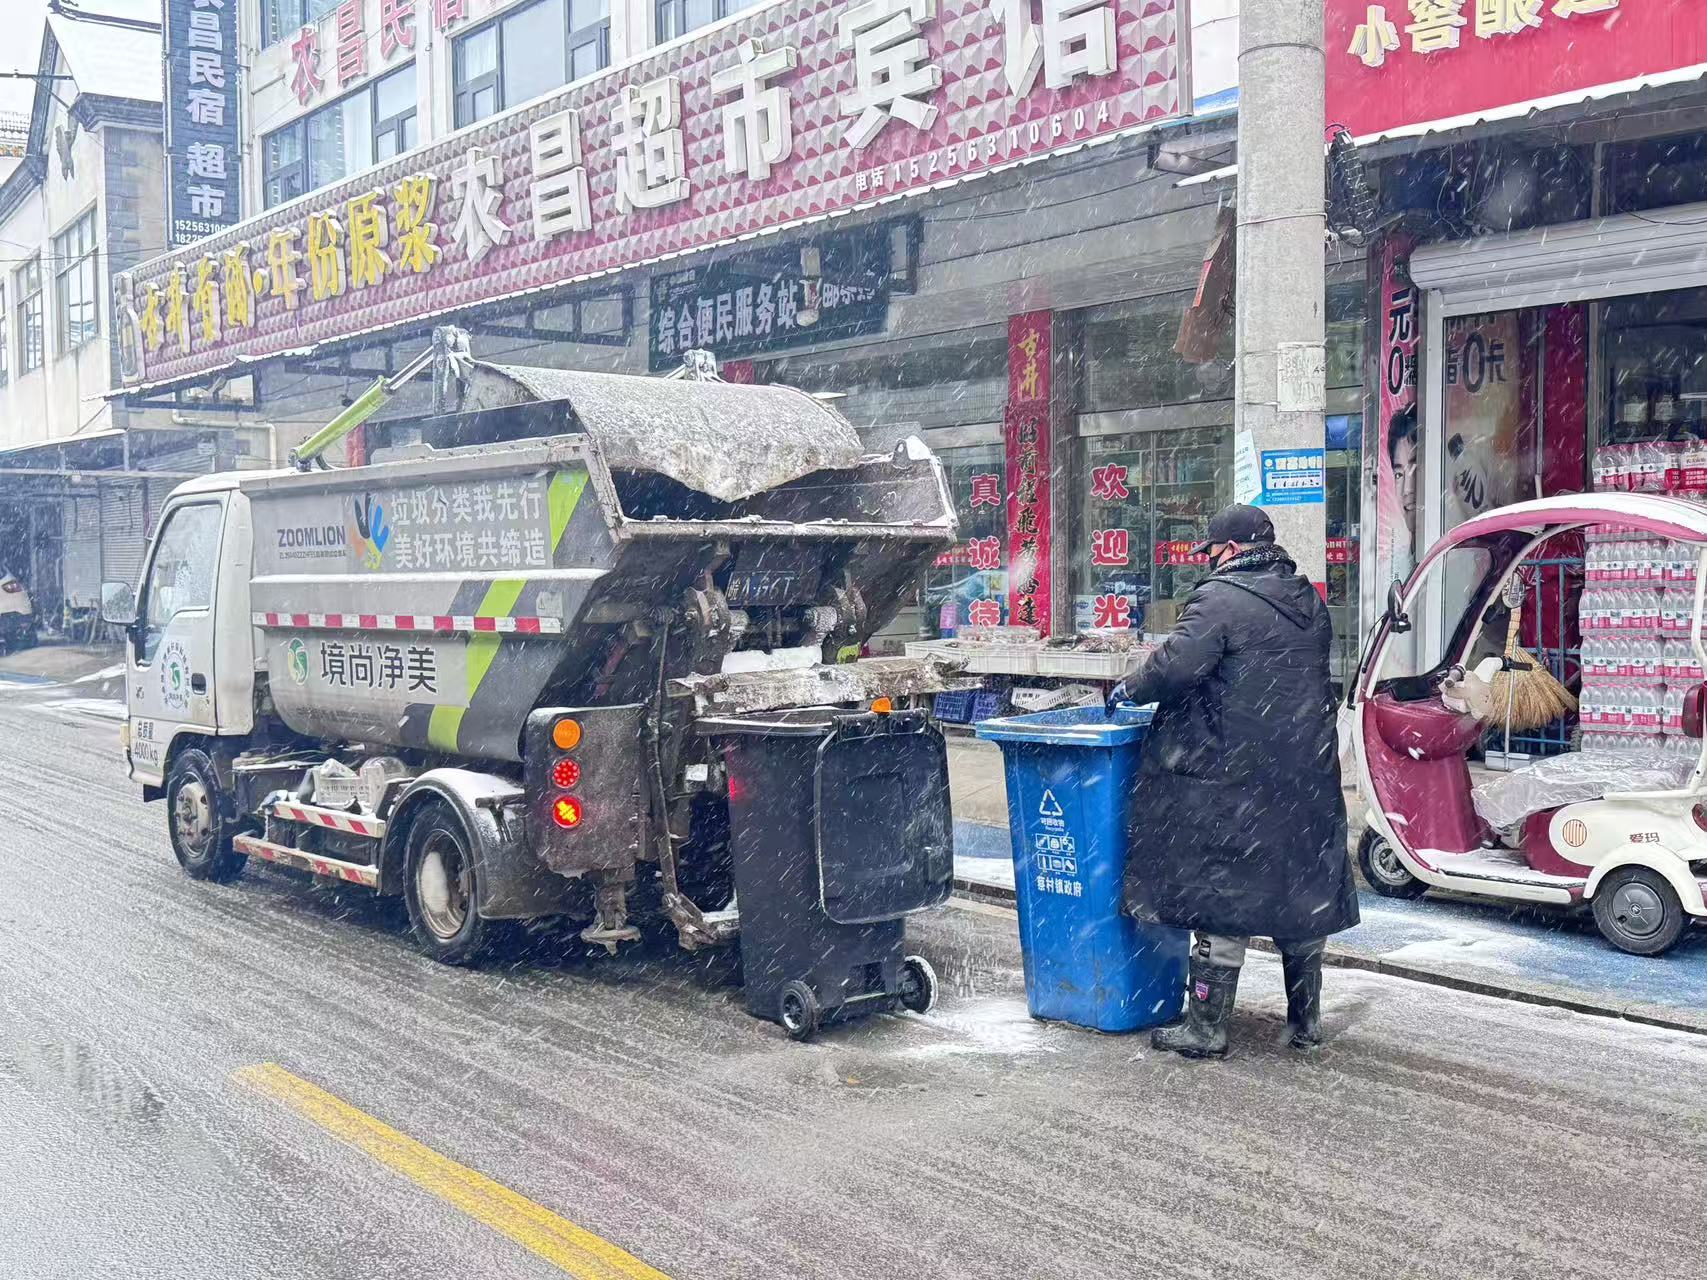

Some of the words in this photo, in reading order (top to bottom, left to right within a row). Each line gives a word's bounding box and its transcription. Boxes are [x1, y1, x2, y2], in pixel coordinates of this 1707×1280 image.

[188, 0, 225, 126] 昌民宿
[1347, 0, 1619, 67] 小窖酿
[855, 167, 884, 192] 电话
[893, 101, 1110, 182] 15256310604
[186, 142, 227, 218] 超市
[657, 279, 799, 354] 综合便民服务站
[391, 481, 542, 526] 垃圾分类我先行
[277, 525, 346, 547] ZOOMLION
[394, 528, 546, 569] 美好环境共缔造
[320, 640, 438, 694] 境尚净美
[1629, 832, 1660, 844] 爱玛
